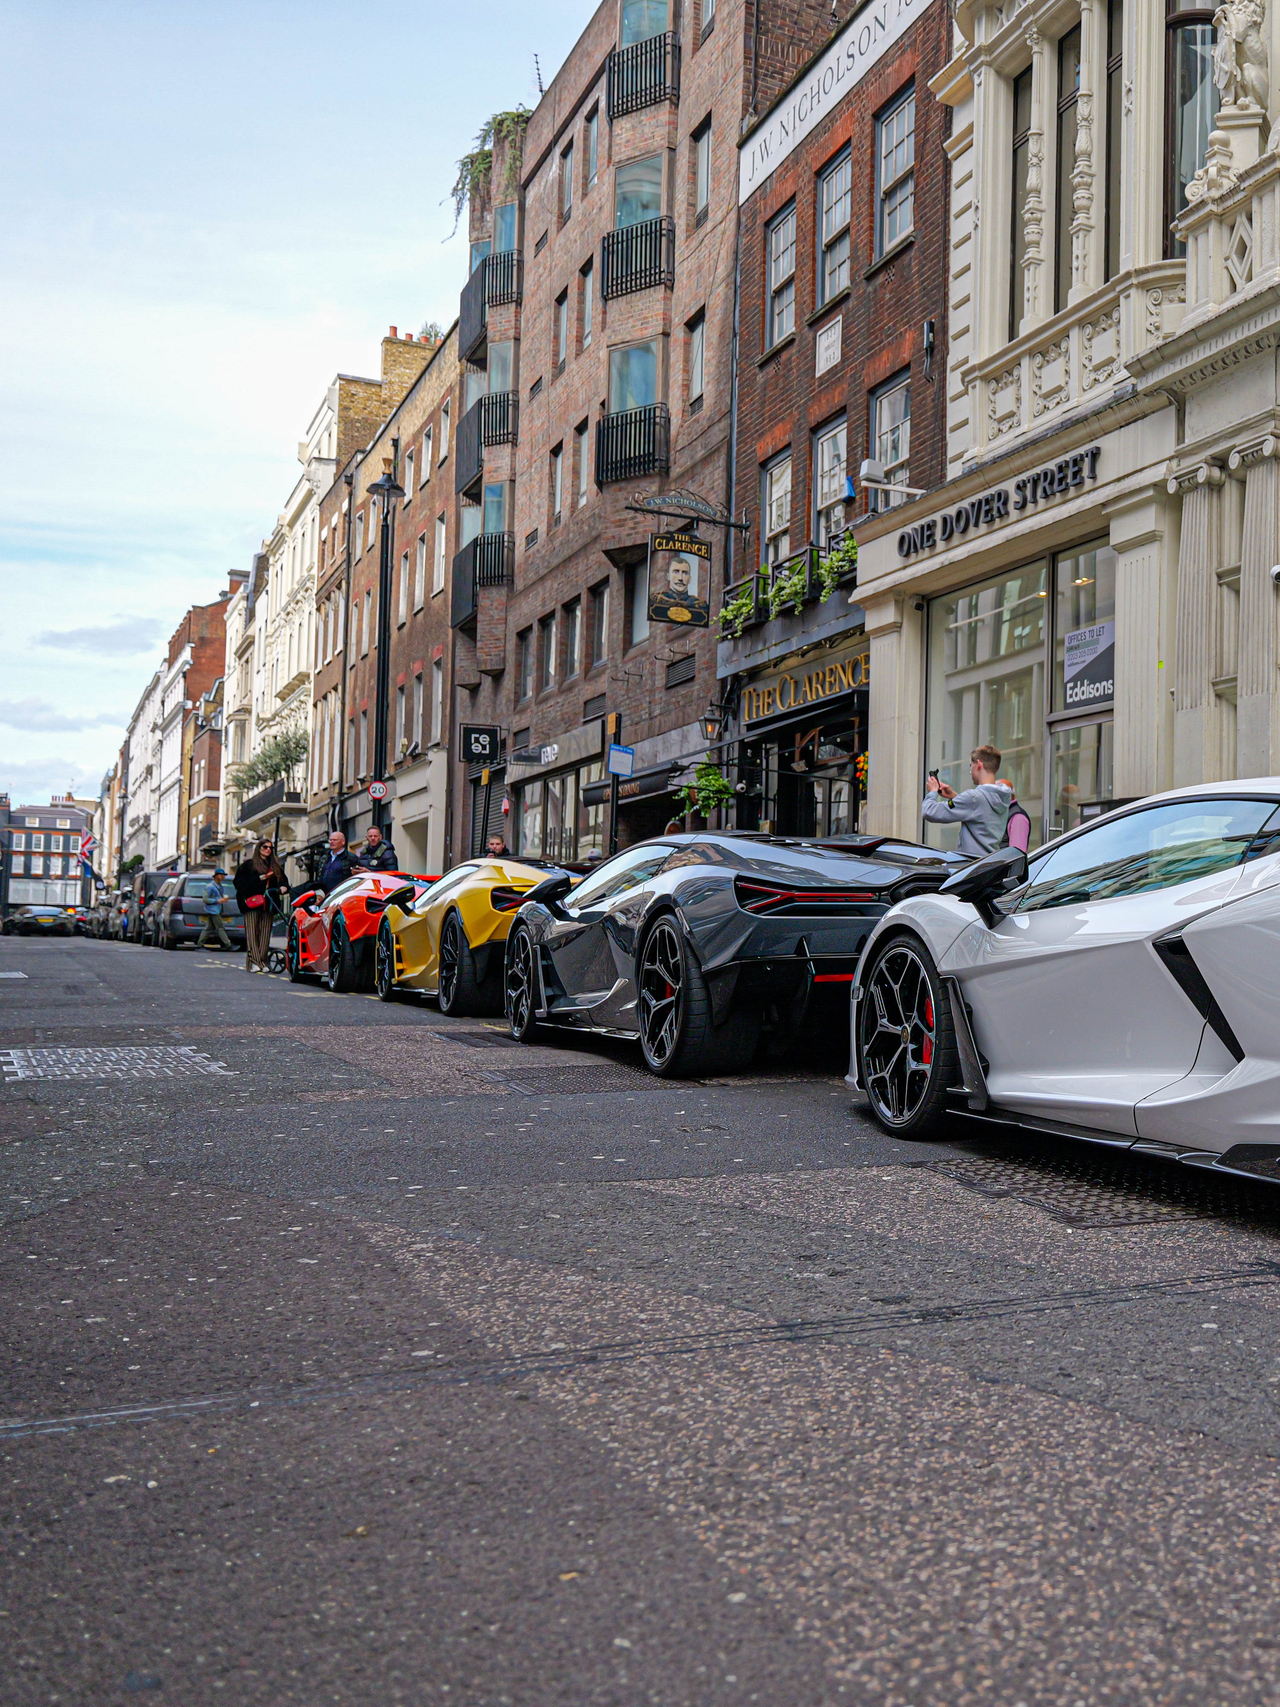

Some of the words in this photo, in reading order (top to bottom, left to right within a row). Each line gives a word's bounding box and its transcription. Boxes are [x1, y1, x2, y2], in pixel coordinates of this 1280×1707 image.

[779, 3, 888, 145] NICHOLSON
[666, 497, 714, 516] NICHOLSON
[897, 519, 937, 558] ONE
[939, 488, 1010, 542] DOVER
[1013, 446, 1101, 511] STREET
[673, 533, 691, 542] THE
[655, 538, 708, 557] CLARENCE
[1068, 631, 1087, 645] OFFICES
[1088, 629, 1095, 639] TO
[1096, 626, 1105, 637] LET
[1066, 679, 1114, 704] Eddisons
[371, 786, 385, 794] 20
